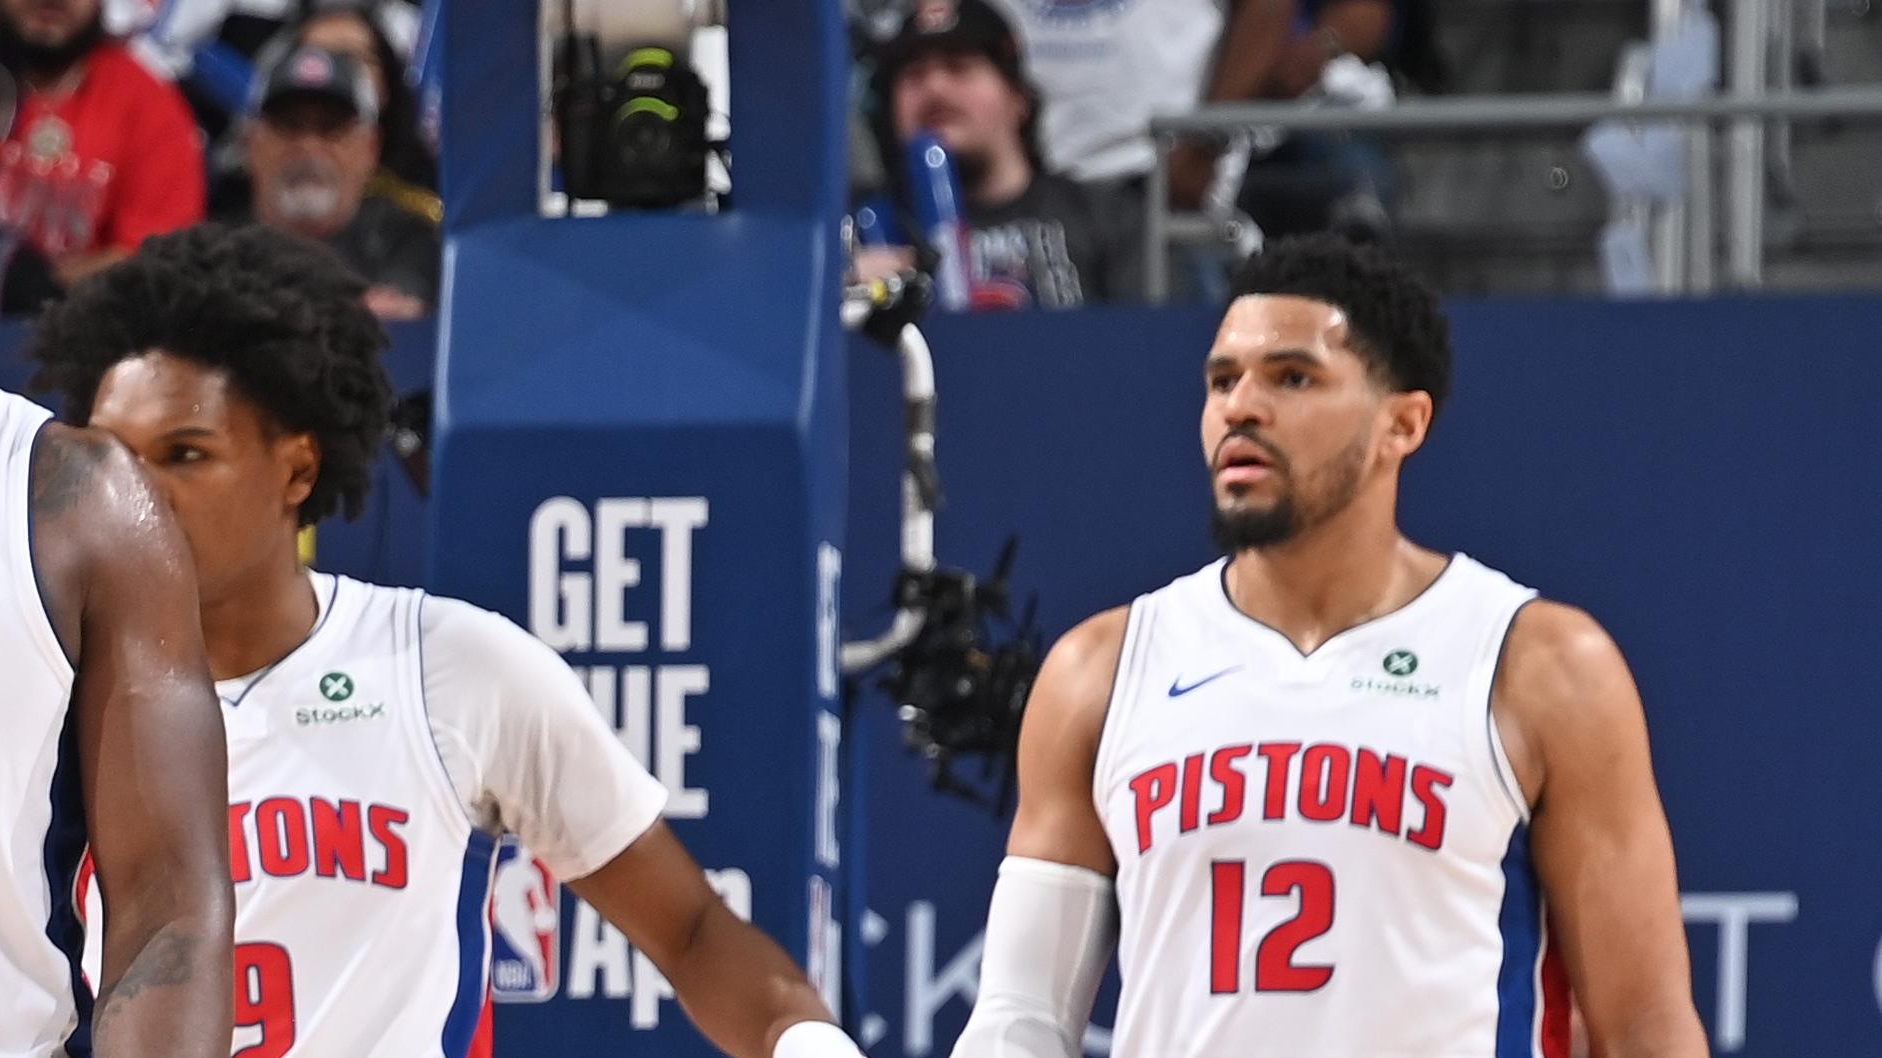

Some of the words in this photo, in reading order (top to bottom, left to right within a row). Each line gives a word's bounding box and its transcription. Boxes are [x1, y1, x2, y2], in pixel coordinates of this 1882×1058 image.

[529, 496, 709, 652] GET
[571, 664, 710, 818] HE
[1128, 742, 1454, 856] PISTONS
[229, 796, 409, 889] TONS
[1211, 859, 1335, 995] 12
